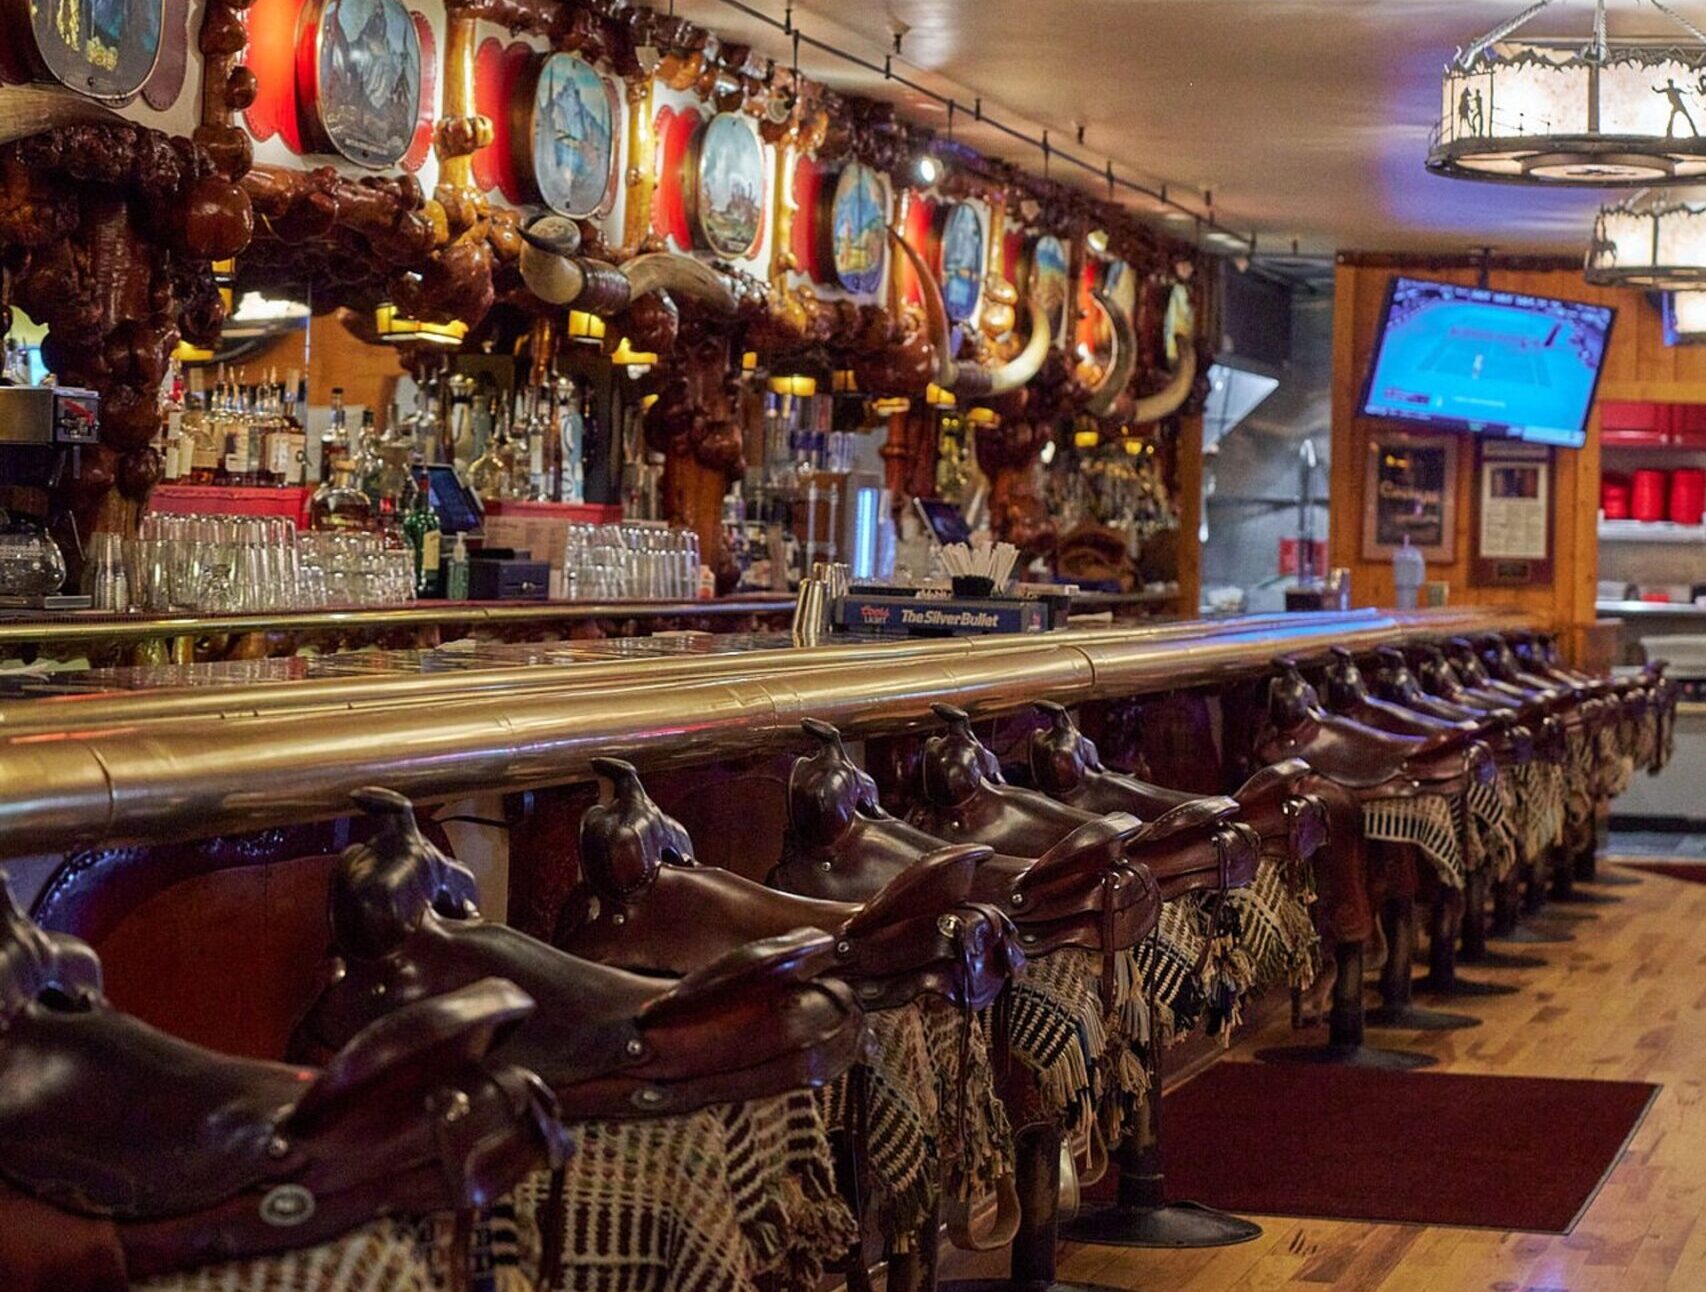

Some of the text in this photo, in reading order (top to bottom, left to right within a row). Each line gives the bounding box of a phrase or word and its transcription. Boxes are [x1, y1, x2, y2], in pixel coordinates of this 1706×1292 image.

[902, 609, 999, 627] The Silver Bullet
